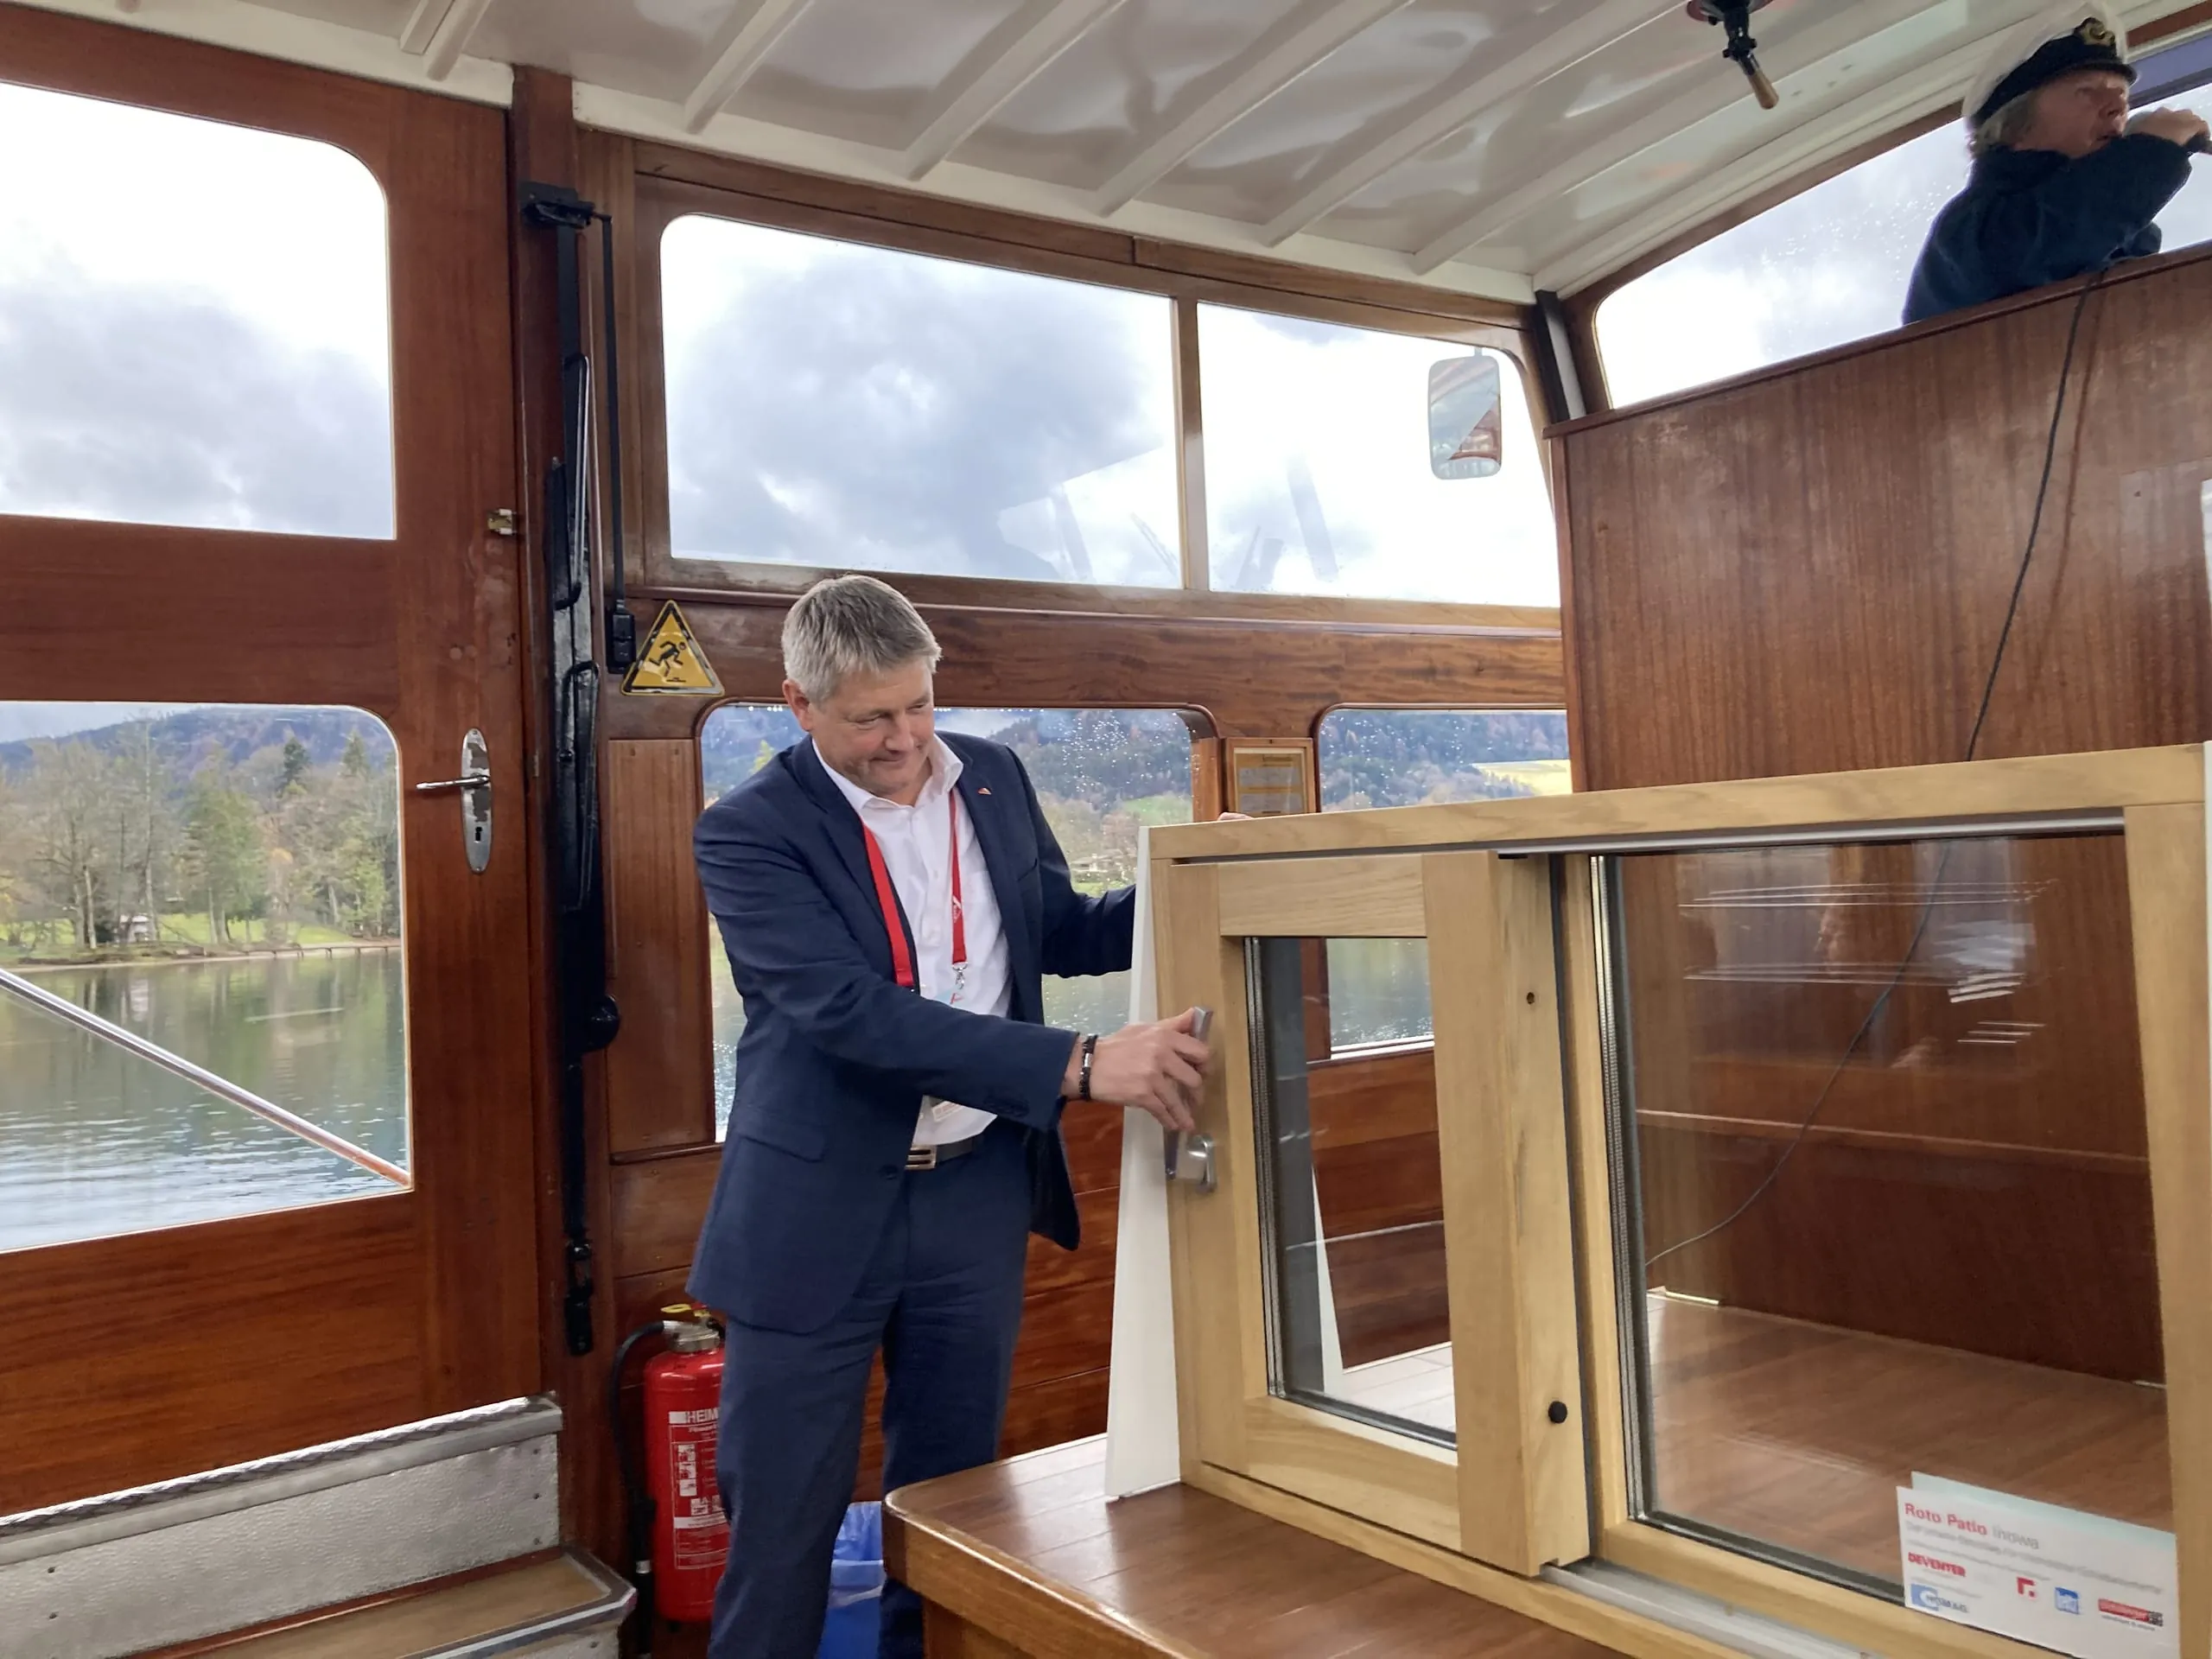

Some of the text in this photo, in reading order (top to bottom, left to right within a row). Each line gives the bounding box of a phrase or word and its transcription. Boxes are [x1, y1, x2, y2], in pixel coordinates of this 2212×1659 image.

[688, 1408, 720, 1423] HEIM
[1905, 1503, 1942, 1523] Roto
[1947, 1514, 1987, 1535] Patio
[1908, 1552, 1966, 1576] DEVENTER
